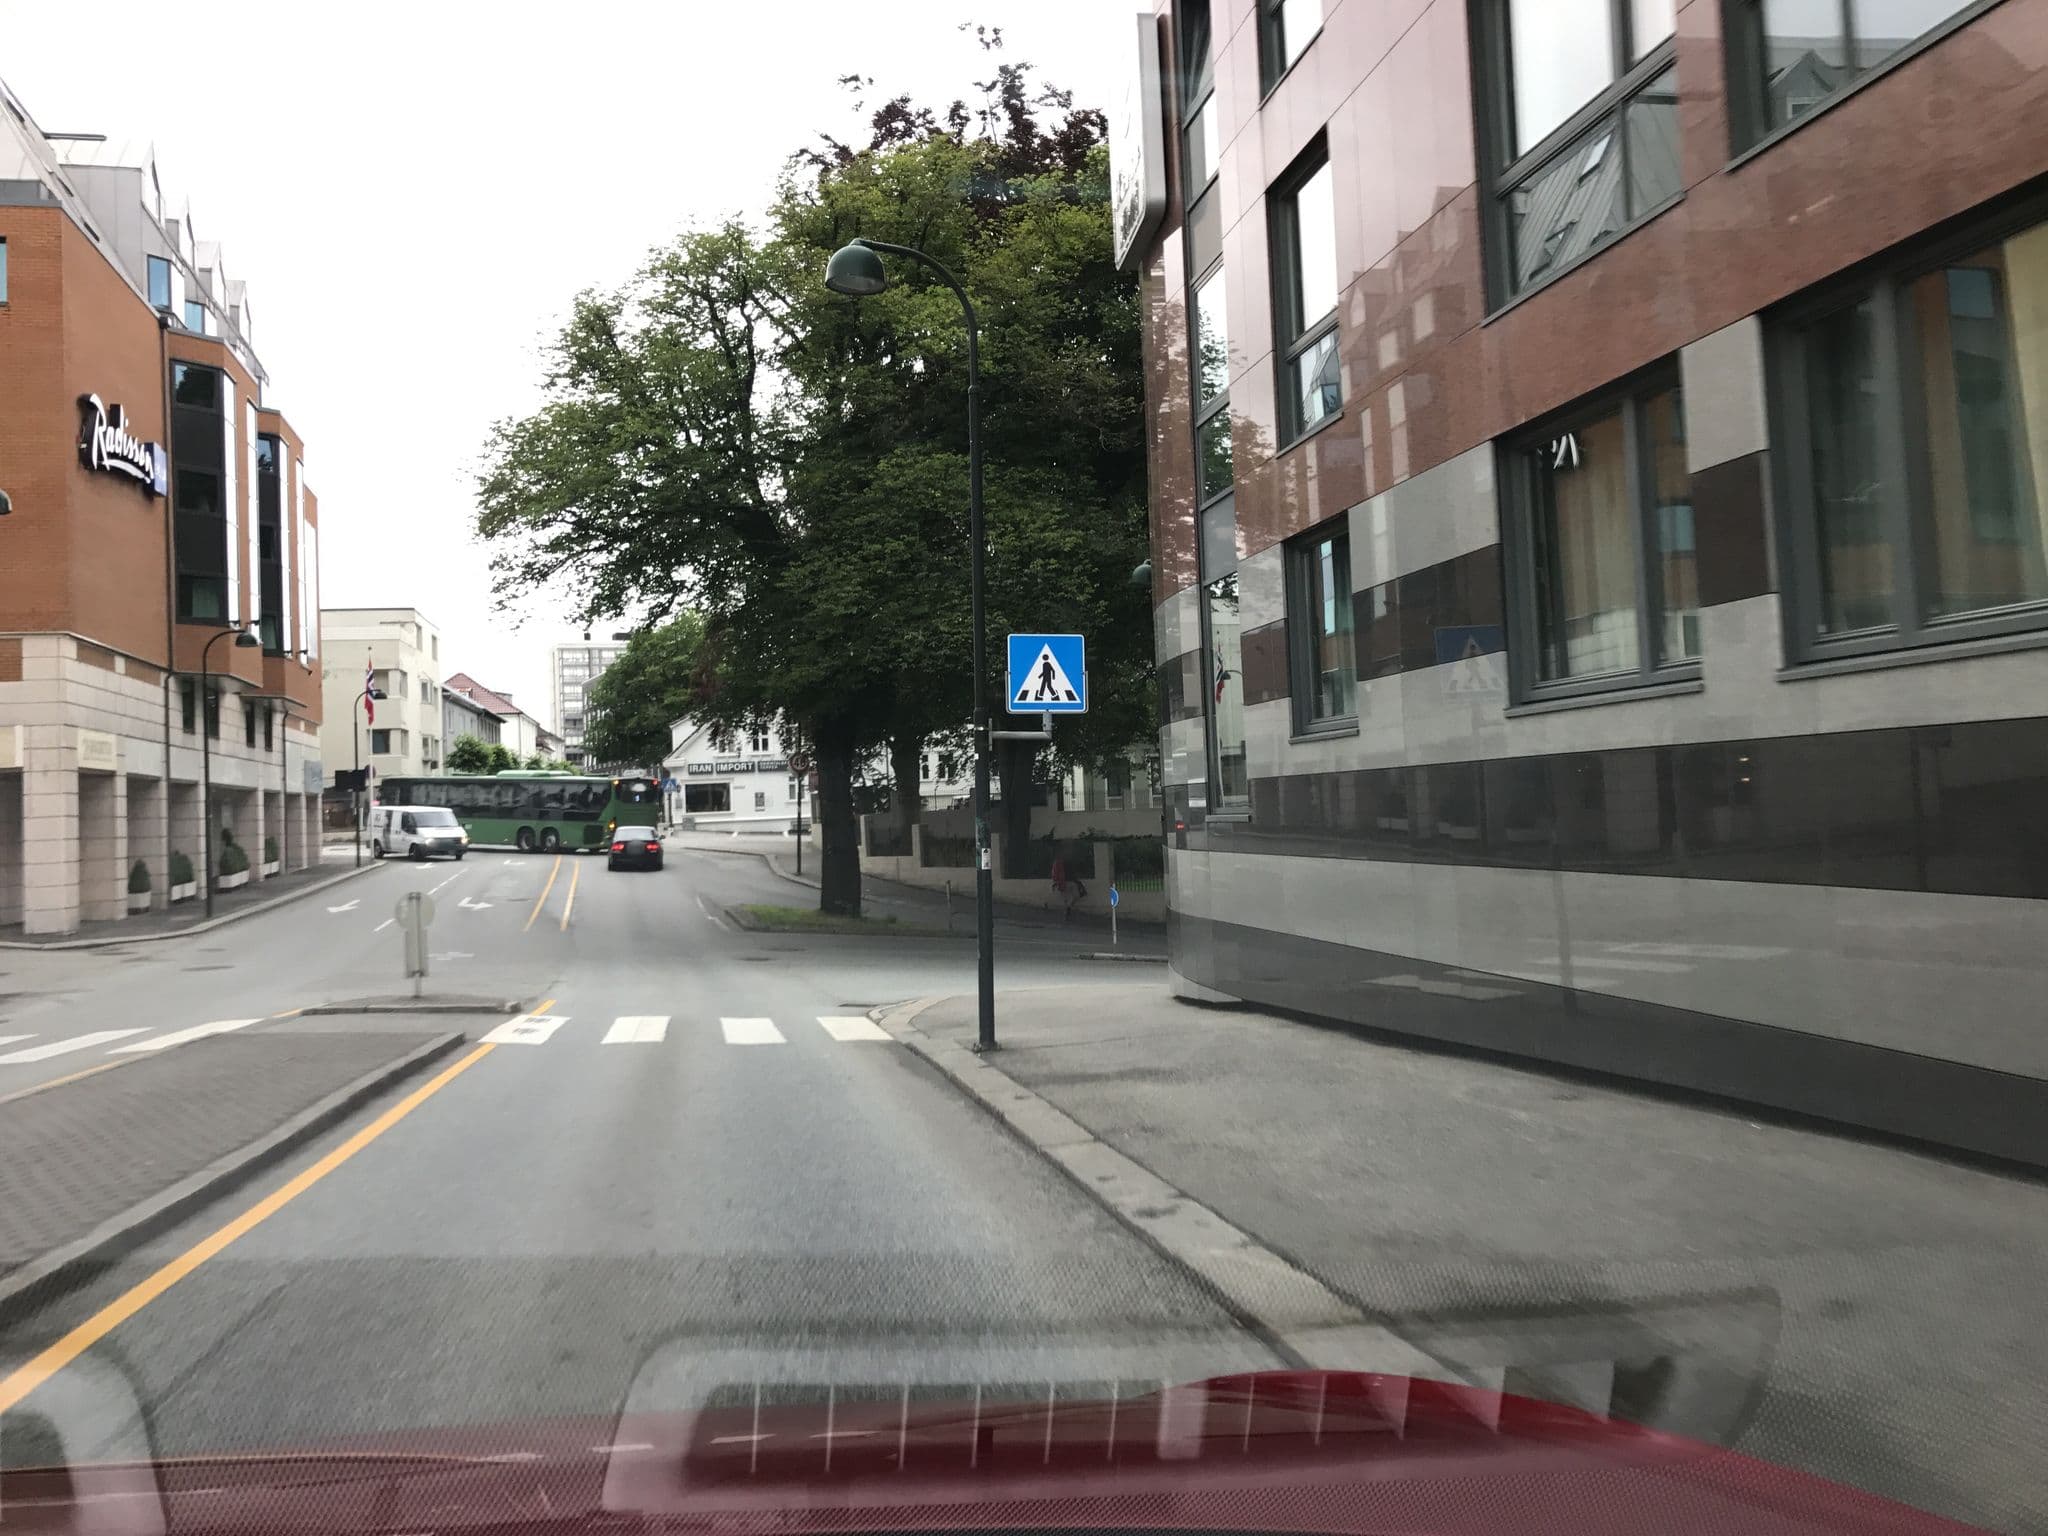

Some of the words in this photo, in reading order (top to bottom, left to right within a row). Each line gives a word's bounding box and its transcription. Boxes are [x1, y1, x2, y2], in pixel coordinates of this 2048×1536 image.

[88, 392, 155, 482] Radisson
[689, 764, 712, 773] IRAN
[716, 762, 753, 772] IMPORT
